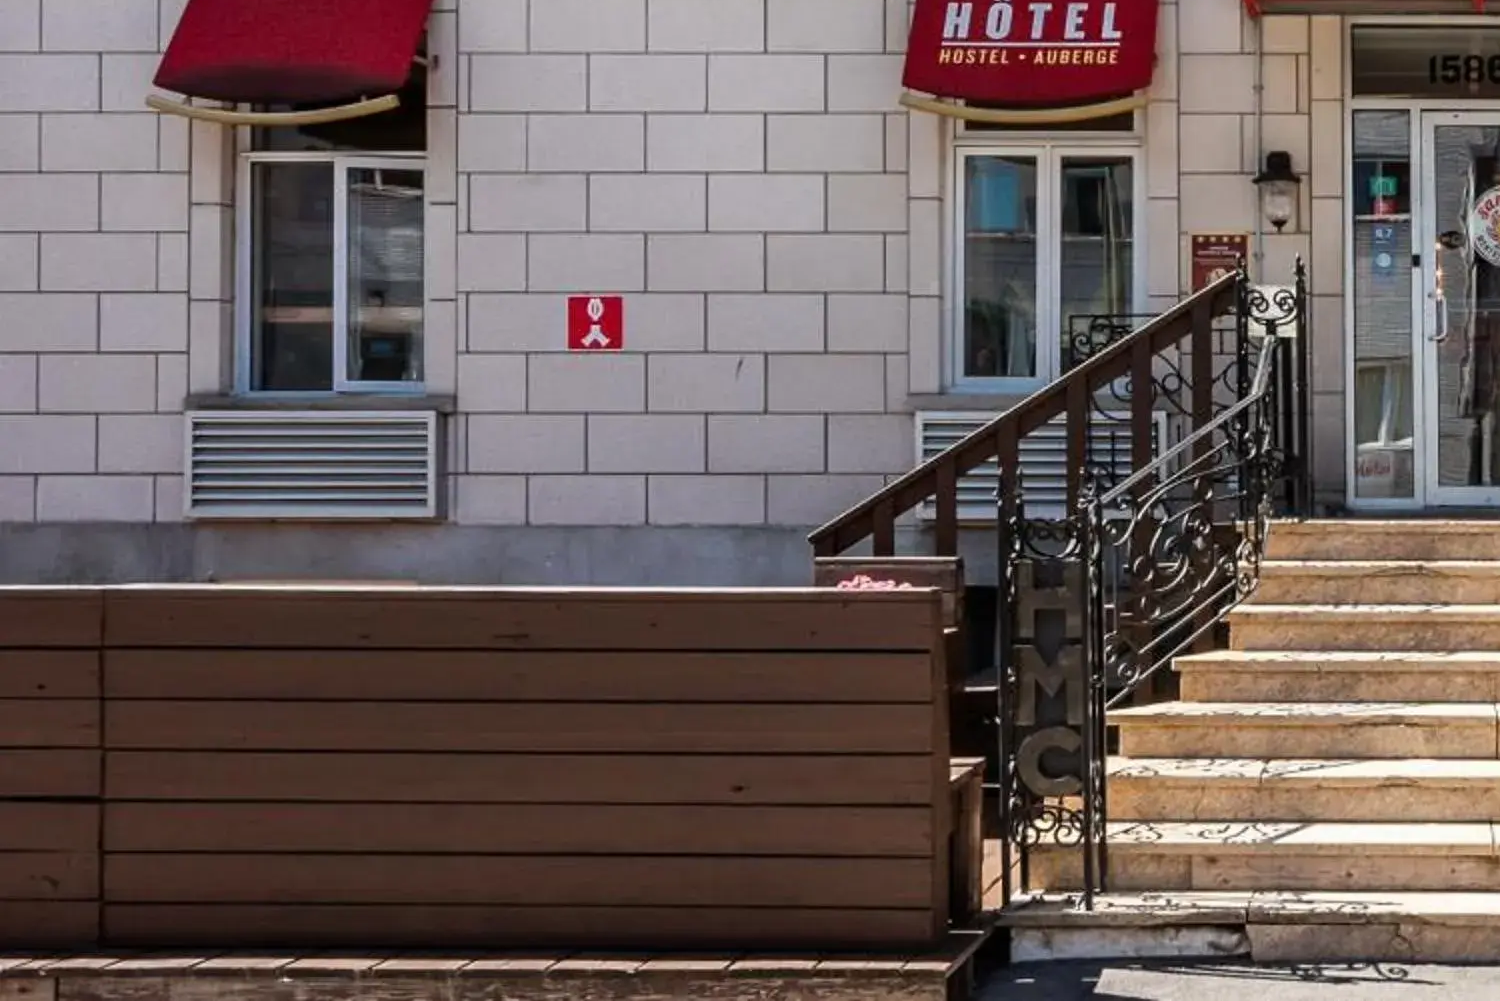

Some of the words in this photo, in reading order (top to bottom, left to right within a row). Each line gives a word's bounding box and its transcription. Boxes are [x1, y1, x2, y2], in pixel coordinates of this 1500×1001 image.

[939, 49, 1010, 65] HOSTEL
[1033, 49, 1119, 65] AUBERGE
[1013, 559, 1083, 796] HMC
